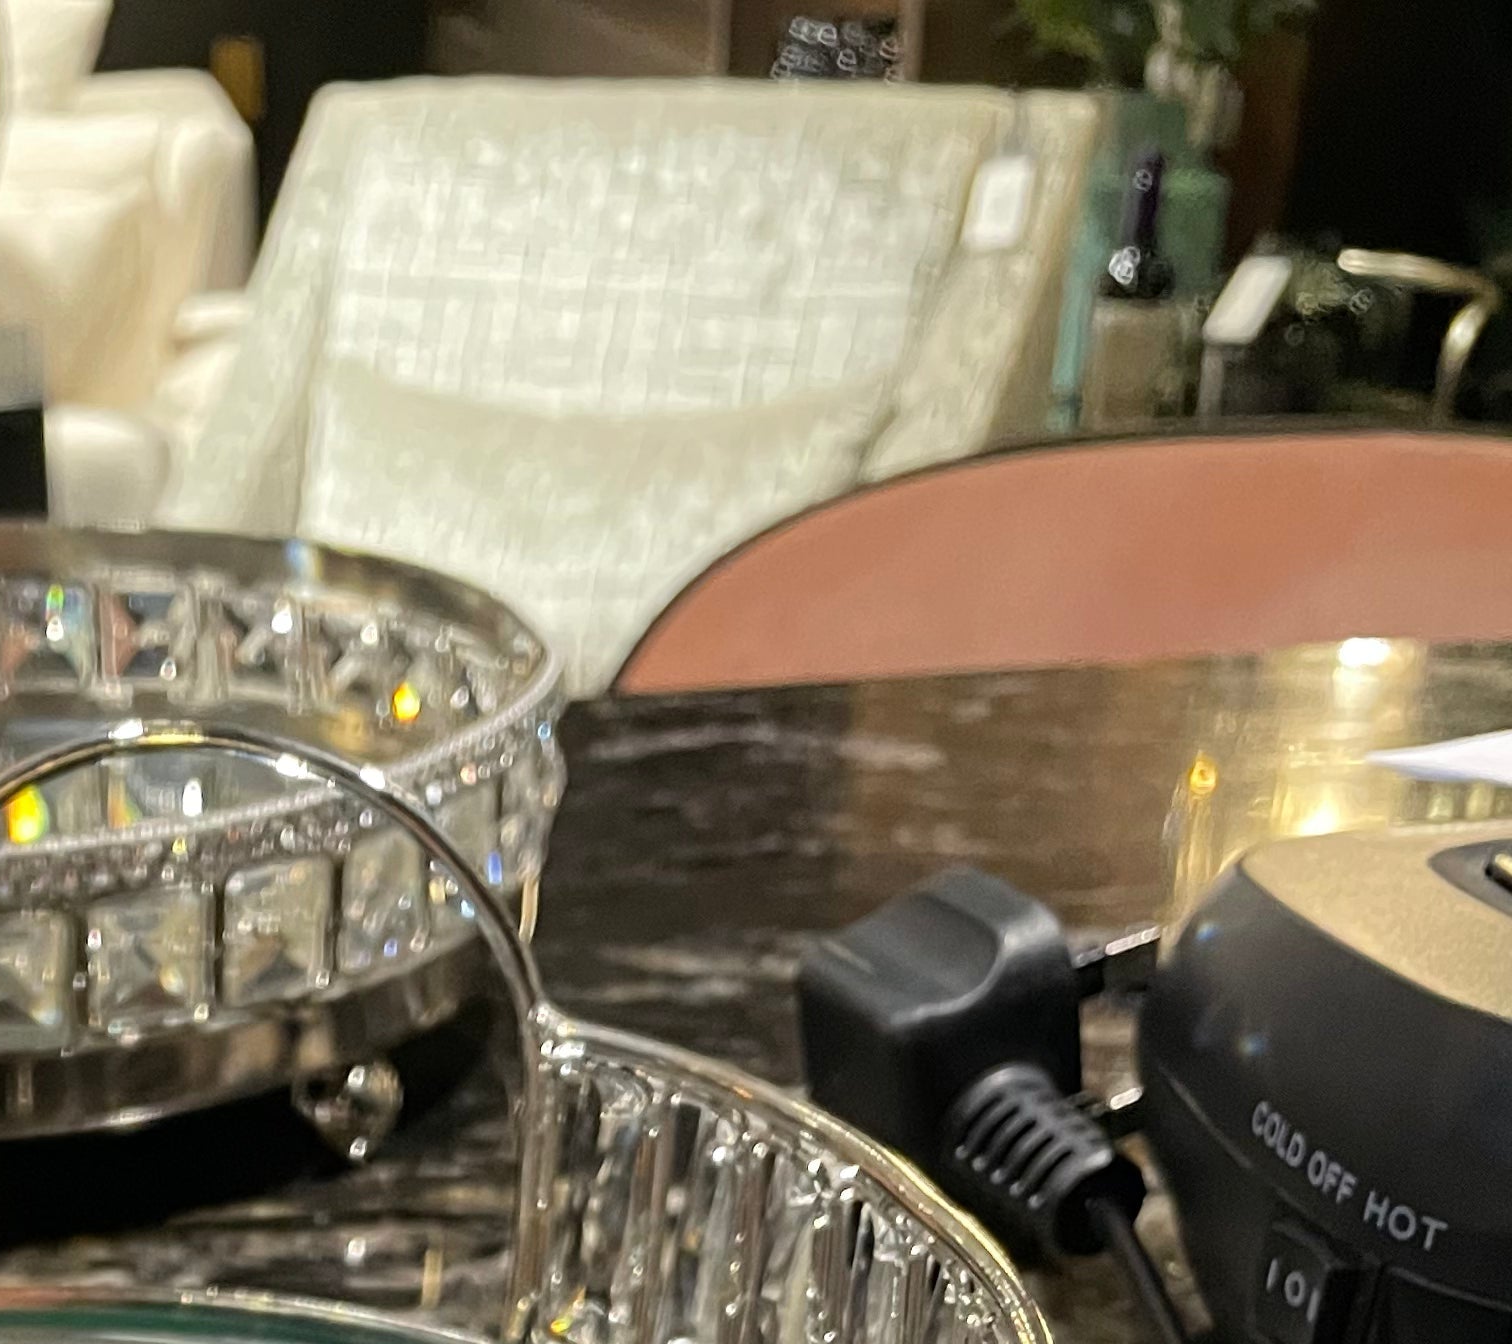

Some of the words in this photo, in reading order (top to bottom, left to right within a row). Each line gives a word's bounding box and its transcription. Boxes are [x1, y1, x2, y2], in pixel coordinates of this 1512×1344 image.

[1251, 1100, 1306, 1168] COLD
[1307, 1150, 1358, 1204] OFF
[1363, 1190, 1449, 1251] HOT
